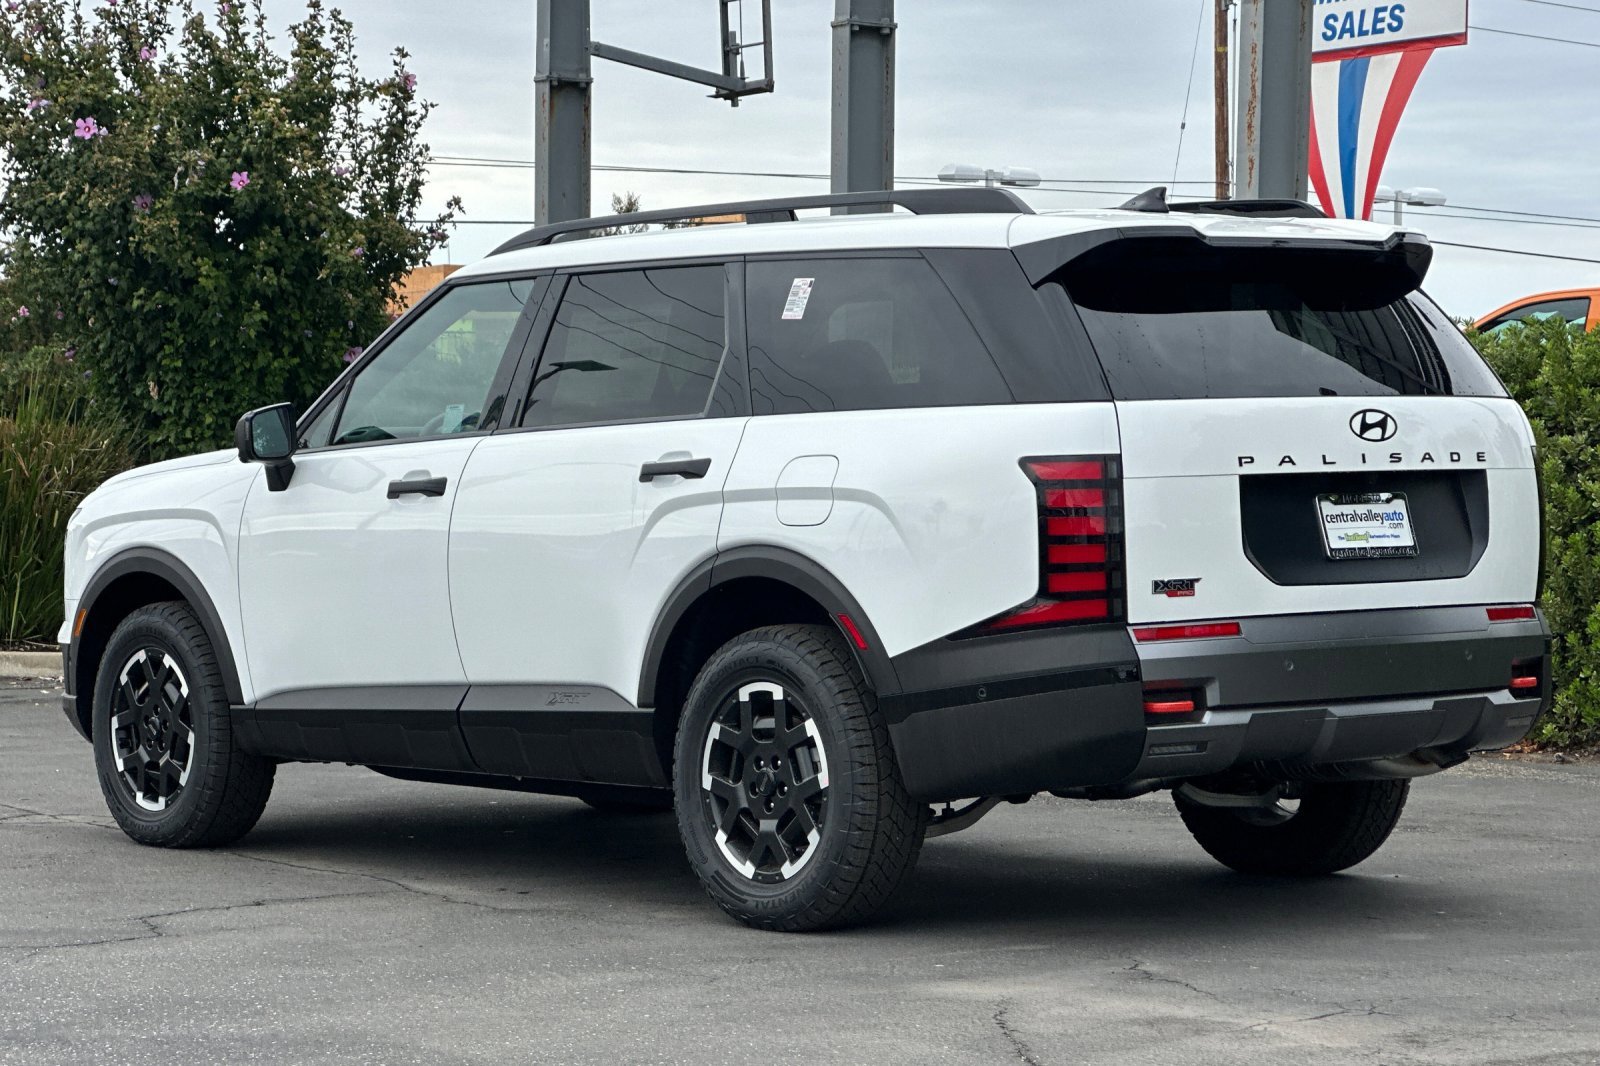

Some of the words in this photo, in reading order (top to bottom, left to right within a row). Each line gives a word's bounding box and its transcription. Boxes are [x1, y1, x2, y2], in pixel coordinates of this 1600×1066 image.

[1321, 3, 1406, 42] SALES
[1237, 451, 1487, 468] PALISADE
[1151, 577, 1203, 595] XRT
[545, 691, 591, 706] XRT
